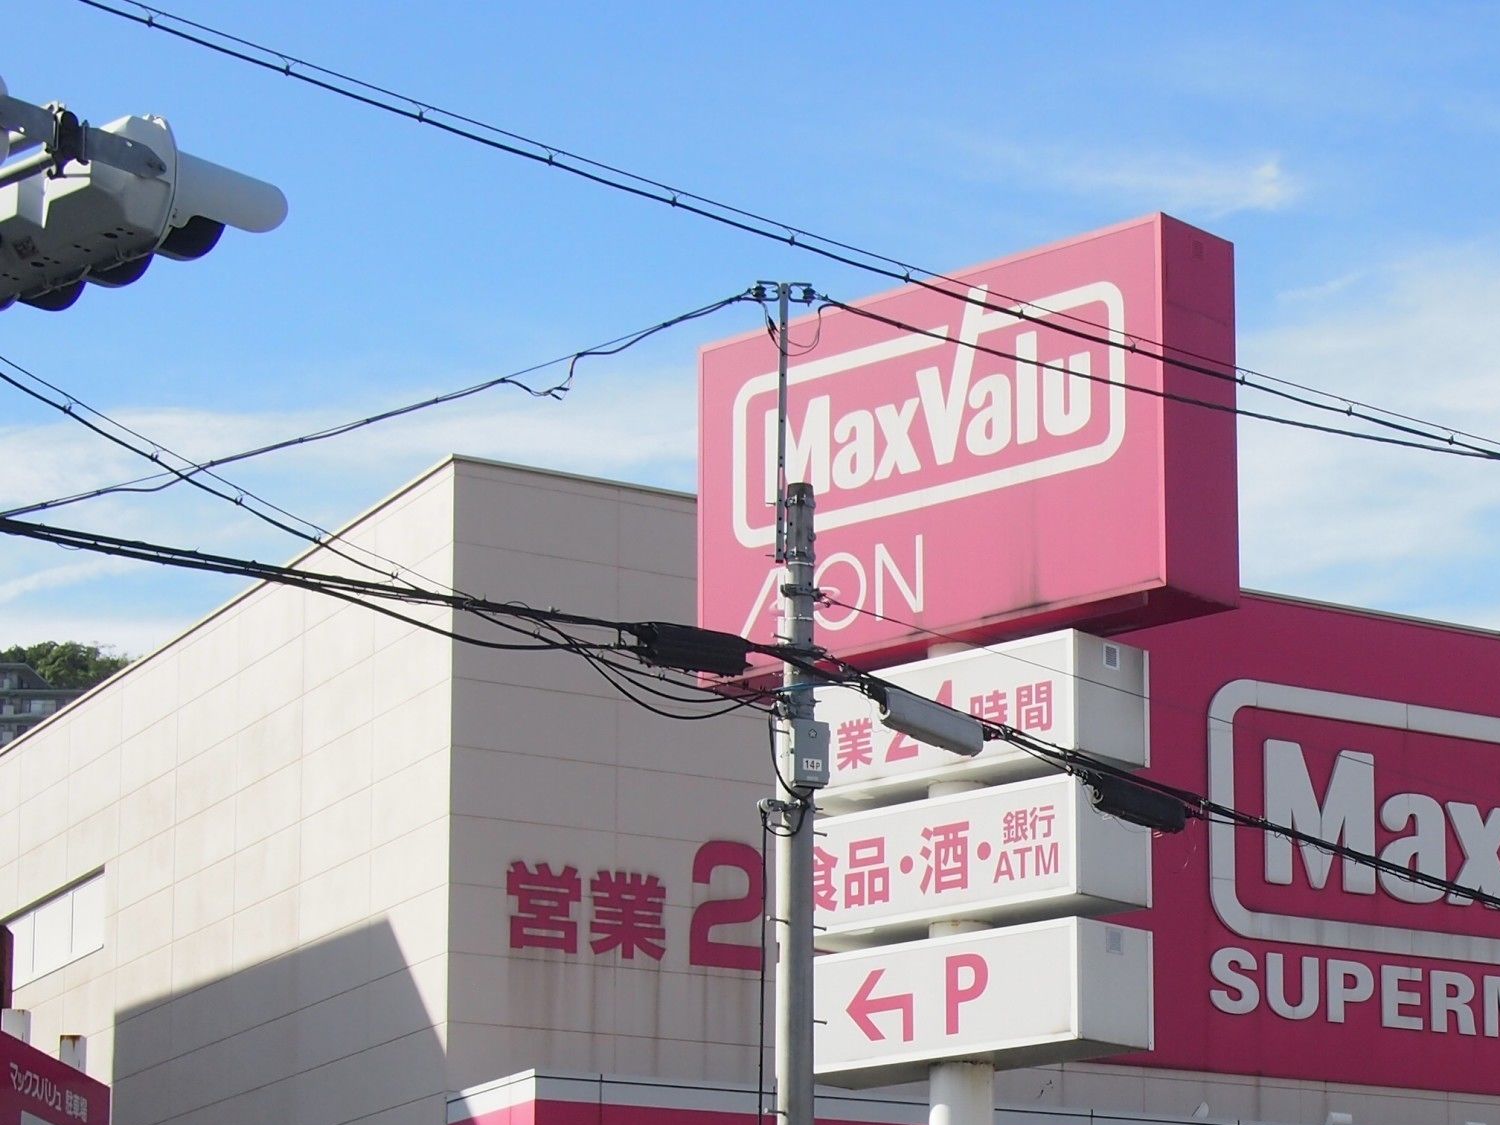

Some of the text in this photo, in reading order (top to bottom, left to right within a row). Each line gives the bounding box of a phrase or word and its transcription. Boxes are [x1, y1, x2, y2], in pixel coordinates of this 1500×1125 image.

[765, 284, 1091, 507] MaxValu
[1002, 805, 1055, 844] 銀行
[993, 842, 1059, 883] ATM
[945, 953, 989, 1036] P
[9, 1062, 61, 1111] マックスバリュ
